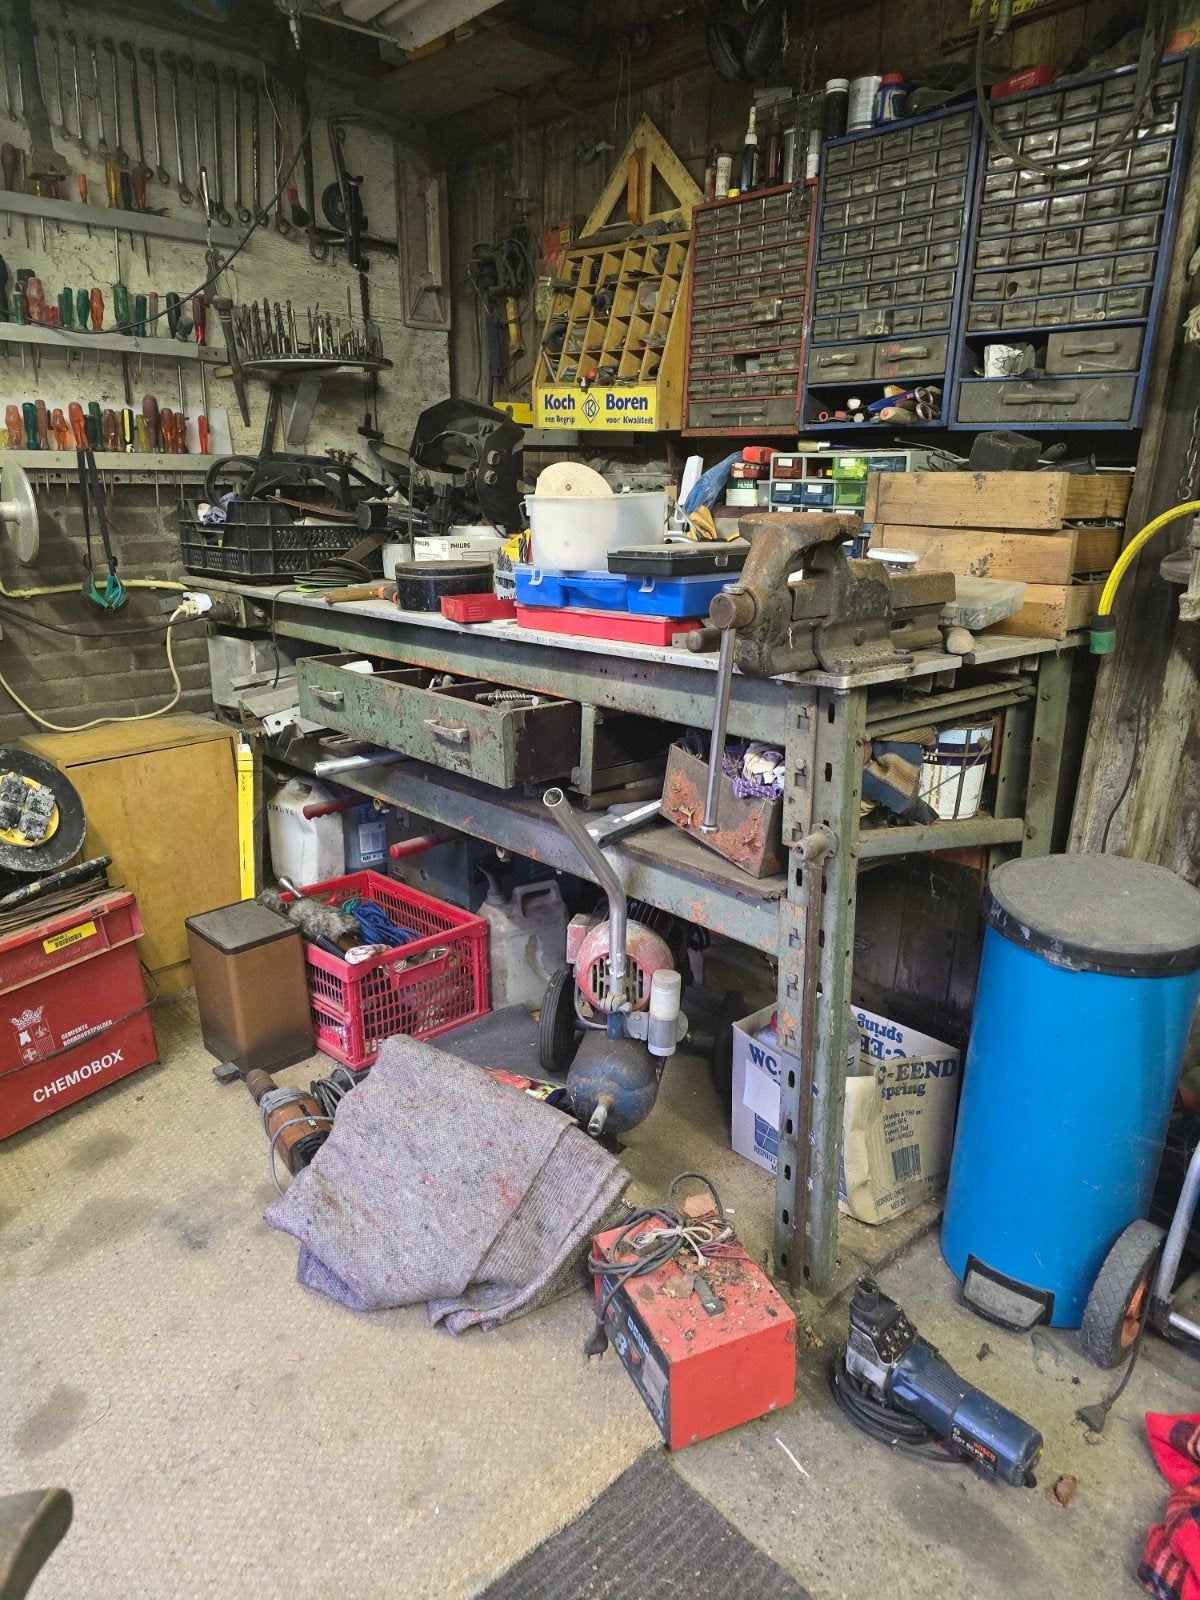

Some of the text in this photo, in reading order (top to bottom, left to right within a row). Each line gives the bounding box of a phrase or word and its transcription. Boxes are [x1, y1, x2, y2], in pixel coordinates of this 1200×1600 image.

[544, 394, 575, 410] Koch
[606, 393, 648, 410] Boren
[556, 415, 575, 425] Begrip
[623, 416, 653, 424] Kwaliteit
[61, 1023, 89, 1040] GEMEENTE
[857, 1012, 904, 1044] spring
[33, 1048, 124, 1103] CHEMOBOX
[973, 1441, 996, 1462] BOSCH
